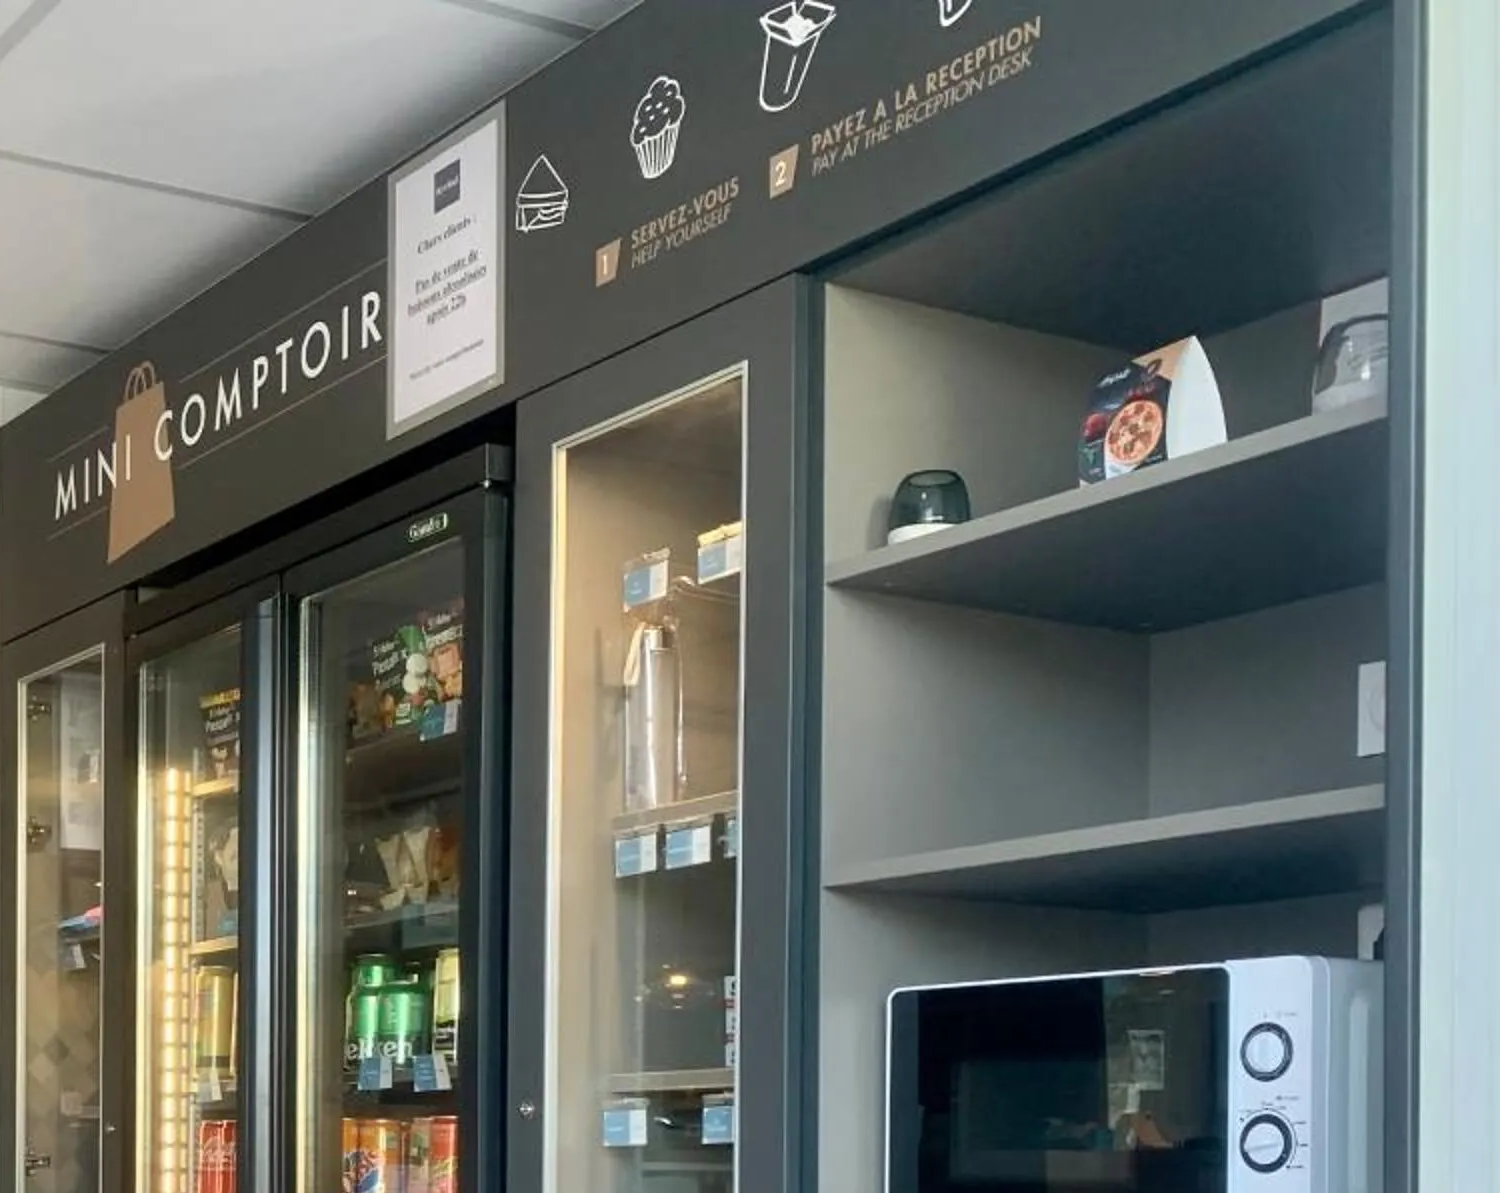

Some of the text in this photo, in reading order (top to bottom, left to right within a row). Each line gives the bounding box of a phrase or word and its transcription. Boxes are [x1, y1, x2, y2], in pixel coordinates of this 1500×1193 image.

[811, 15, 1041, 155] PAYEZ A LA RECEPTION
[811, 46, 1034, 177] PAY AT THE RECEPTION DESK
[775, 160, 787, 187] 2
[631, 176, 739, 249] SERVEZ-VOUS
[631, 203, 733, 269] HELP YOURSELF
[602, 254, 608, 275] 1
[55, 291, 382, 520] MINI COMPTOIR
